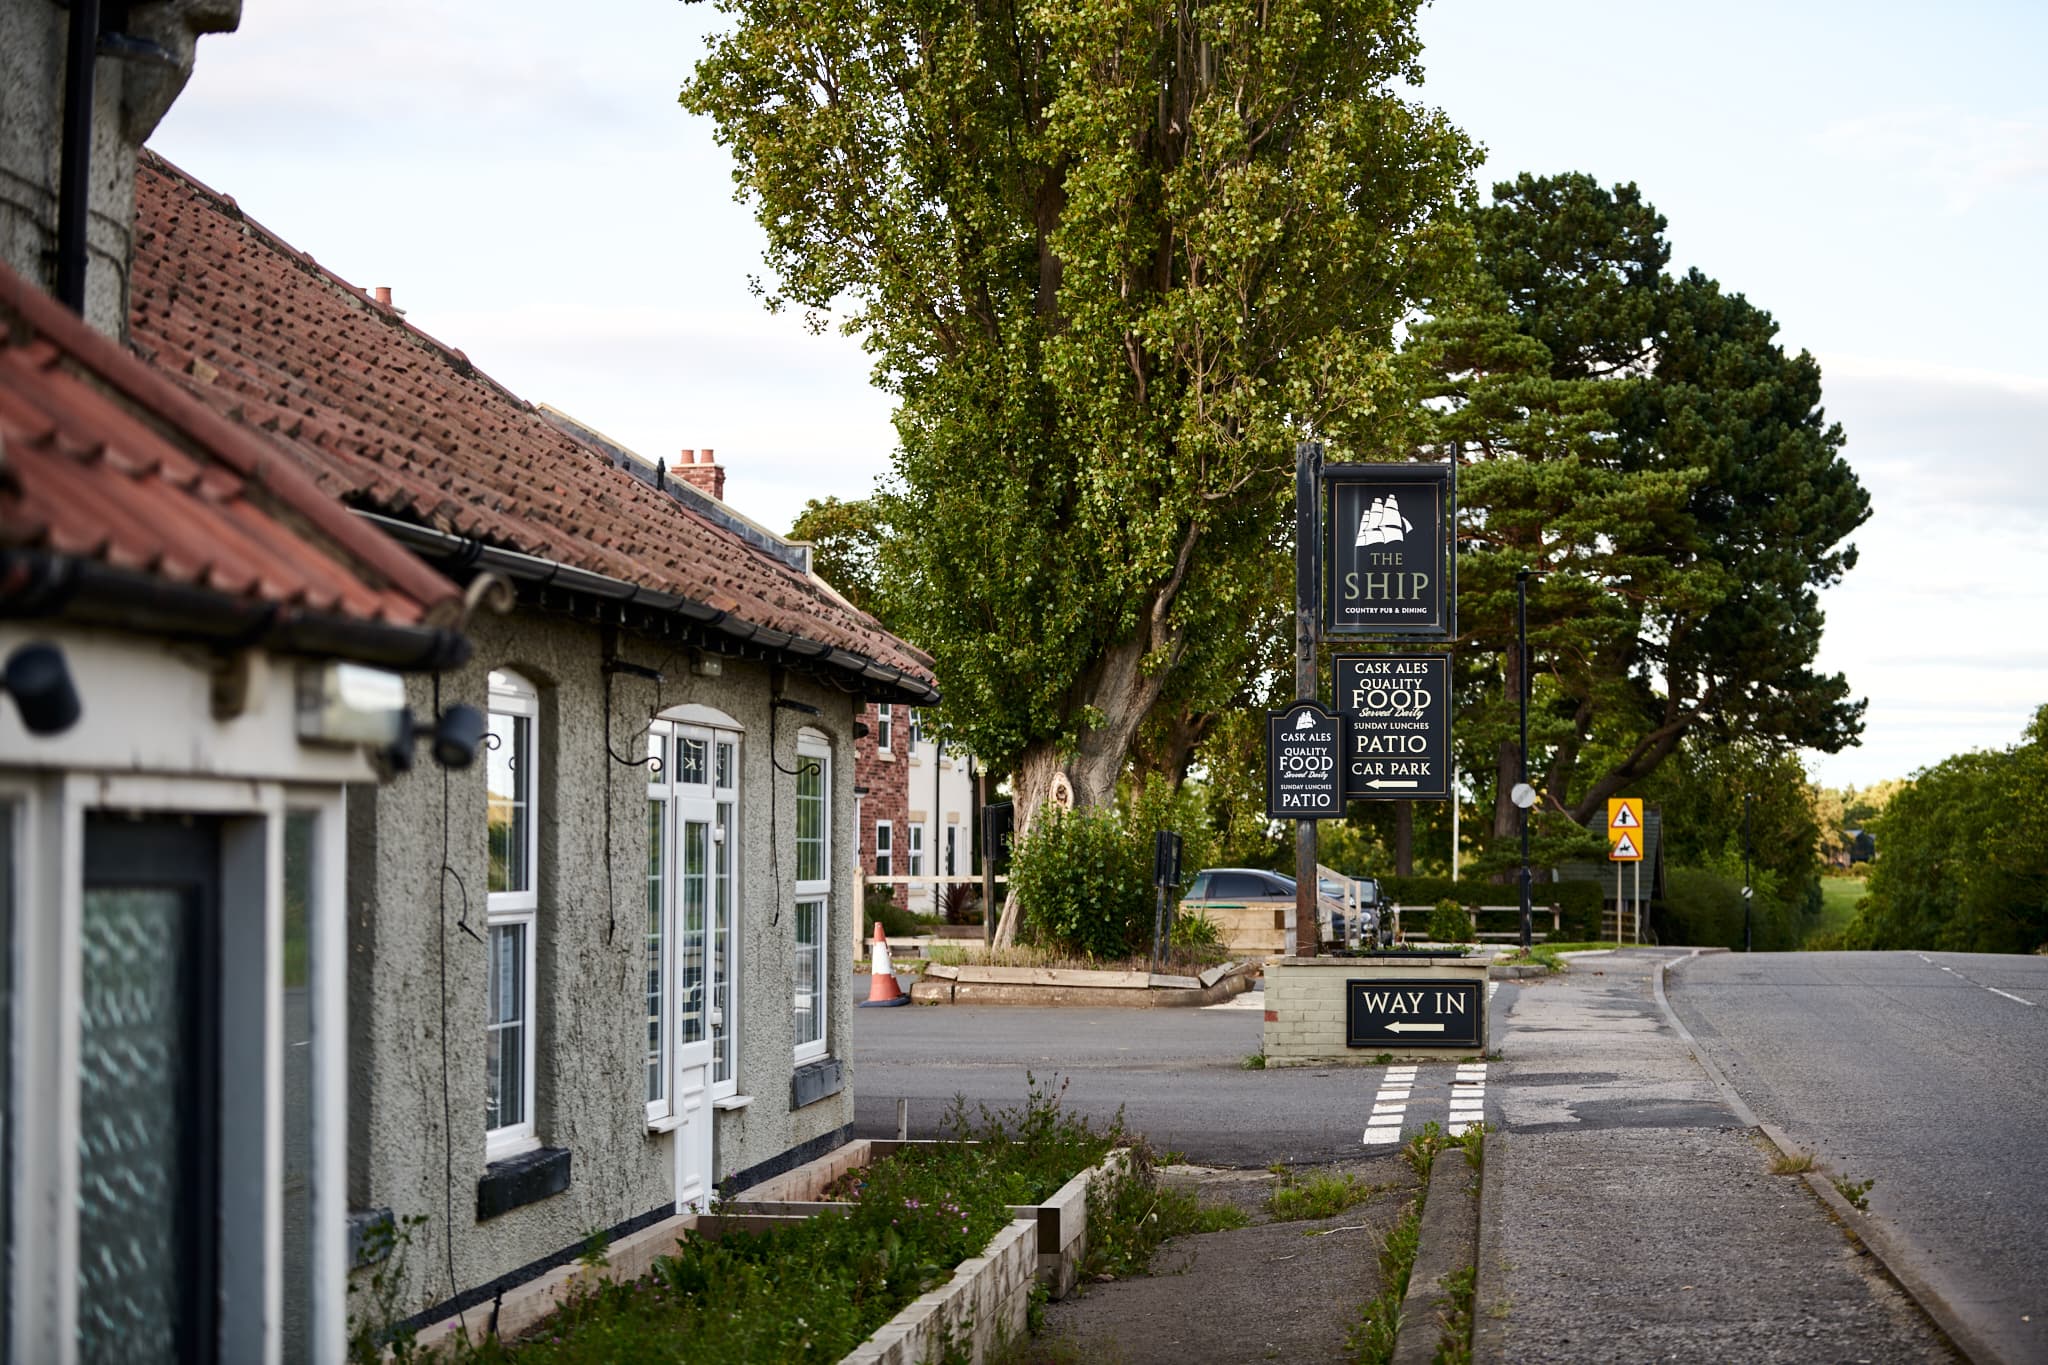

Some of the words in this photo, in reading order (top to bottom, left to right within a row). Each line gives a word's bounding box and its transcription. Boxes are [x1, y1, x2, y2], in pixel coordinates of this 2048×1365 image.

[1370, 552, 1403, 565] THE
[1344, 572, 1429, 600] SHIP
[1354, 663, 1391, 674] CASK
[1396, 663, 1428, 674] ALES
[1360, 678, 1422, 690] QUALITY
[1352, 689, 1431, 709] FOOD
[1359, 708, 1392, 717] Served
[1394, 708, 1424, 720] Daily
[1280, 733, 1306, 741] CASK
[1309, 733, 1331, 741] ALES
[1356, 735, 1426, 753] PATIO
[1284, 747, 1327, 756] QUALITY
[1279, 756, 1333, 771] FOOD
[1352, 763, 1384, 775] CAR
[1391, 763, 1431, 775] PARK
[1284, 770, 1306, 778] Served
[1308, 771, 1328, 780] Daily
[1282, 794, 1330, 807] PATIO
[1362, 992, 1425, 1014] WAY
[1434, 992, 1466, 1014] IN
